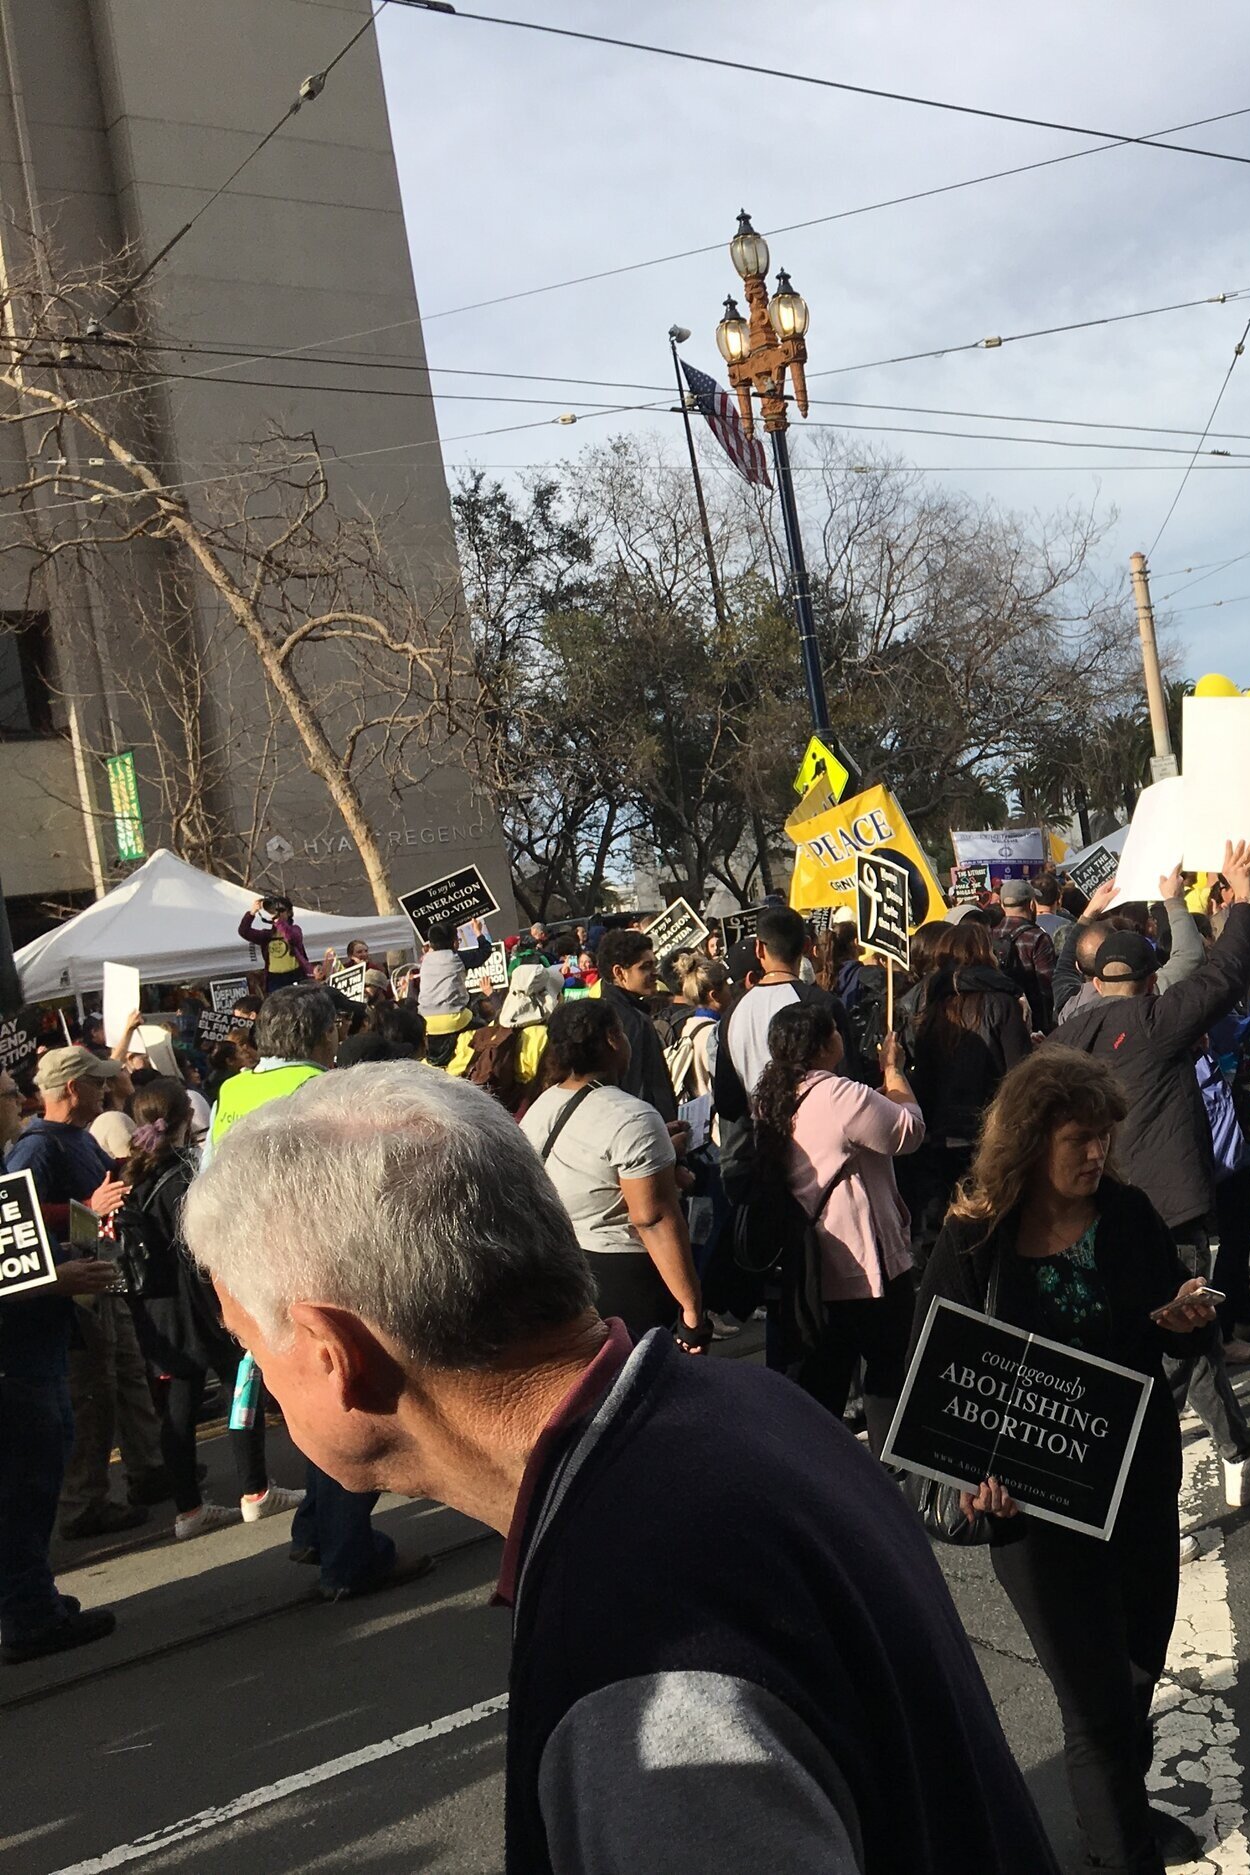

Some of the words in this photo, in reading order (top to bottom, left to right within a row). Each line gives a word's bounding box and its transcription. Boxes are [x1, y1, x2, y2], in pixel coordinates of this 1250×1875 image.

[388, 822, 498, 847] REGENCY
[808, 809, 893, 867] PEACE
[1081, 859, 1117, 893] PRO-LIFE
[1083, 866, 1094, 879] AM
[1094, 854, 1109, 867] THE
[412, 882, 481, 918] GENERACION
[427, 888, 437, 898] Yo
[438, 884, 448, 894] soy
[448, 880, 456, 889] la
[427, 896, 480, 924] PRO-VIDA
[658, 912, 691, 946] ERACION
[655, 926, 692, 961] PRO-VIDA
[465, 964, 504, 980] ANNED
[214, 986, 248, 1001] DEFUND
[0, 1018, 18, 1038] AY
[198, 1019, 211, 1030] EL
[213, 1022, 231, 1033] FIN
[201, 1010, 229, 1025] REZA
[231, 1016, 255, 1028] POR
[981, 1350, 1086, 1402] courageously
[939, 1362, 1110, 1438] ABOLISHING
[942, 1396, 1090, 1464] ABORTION
